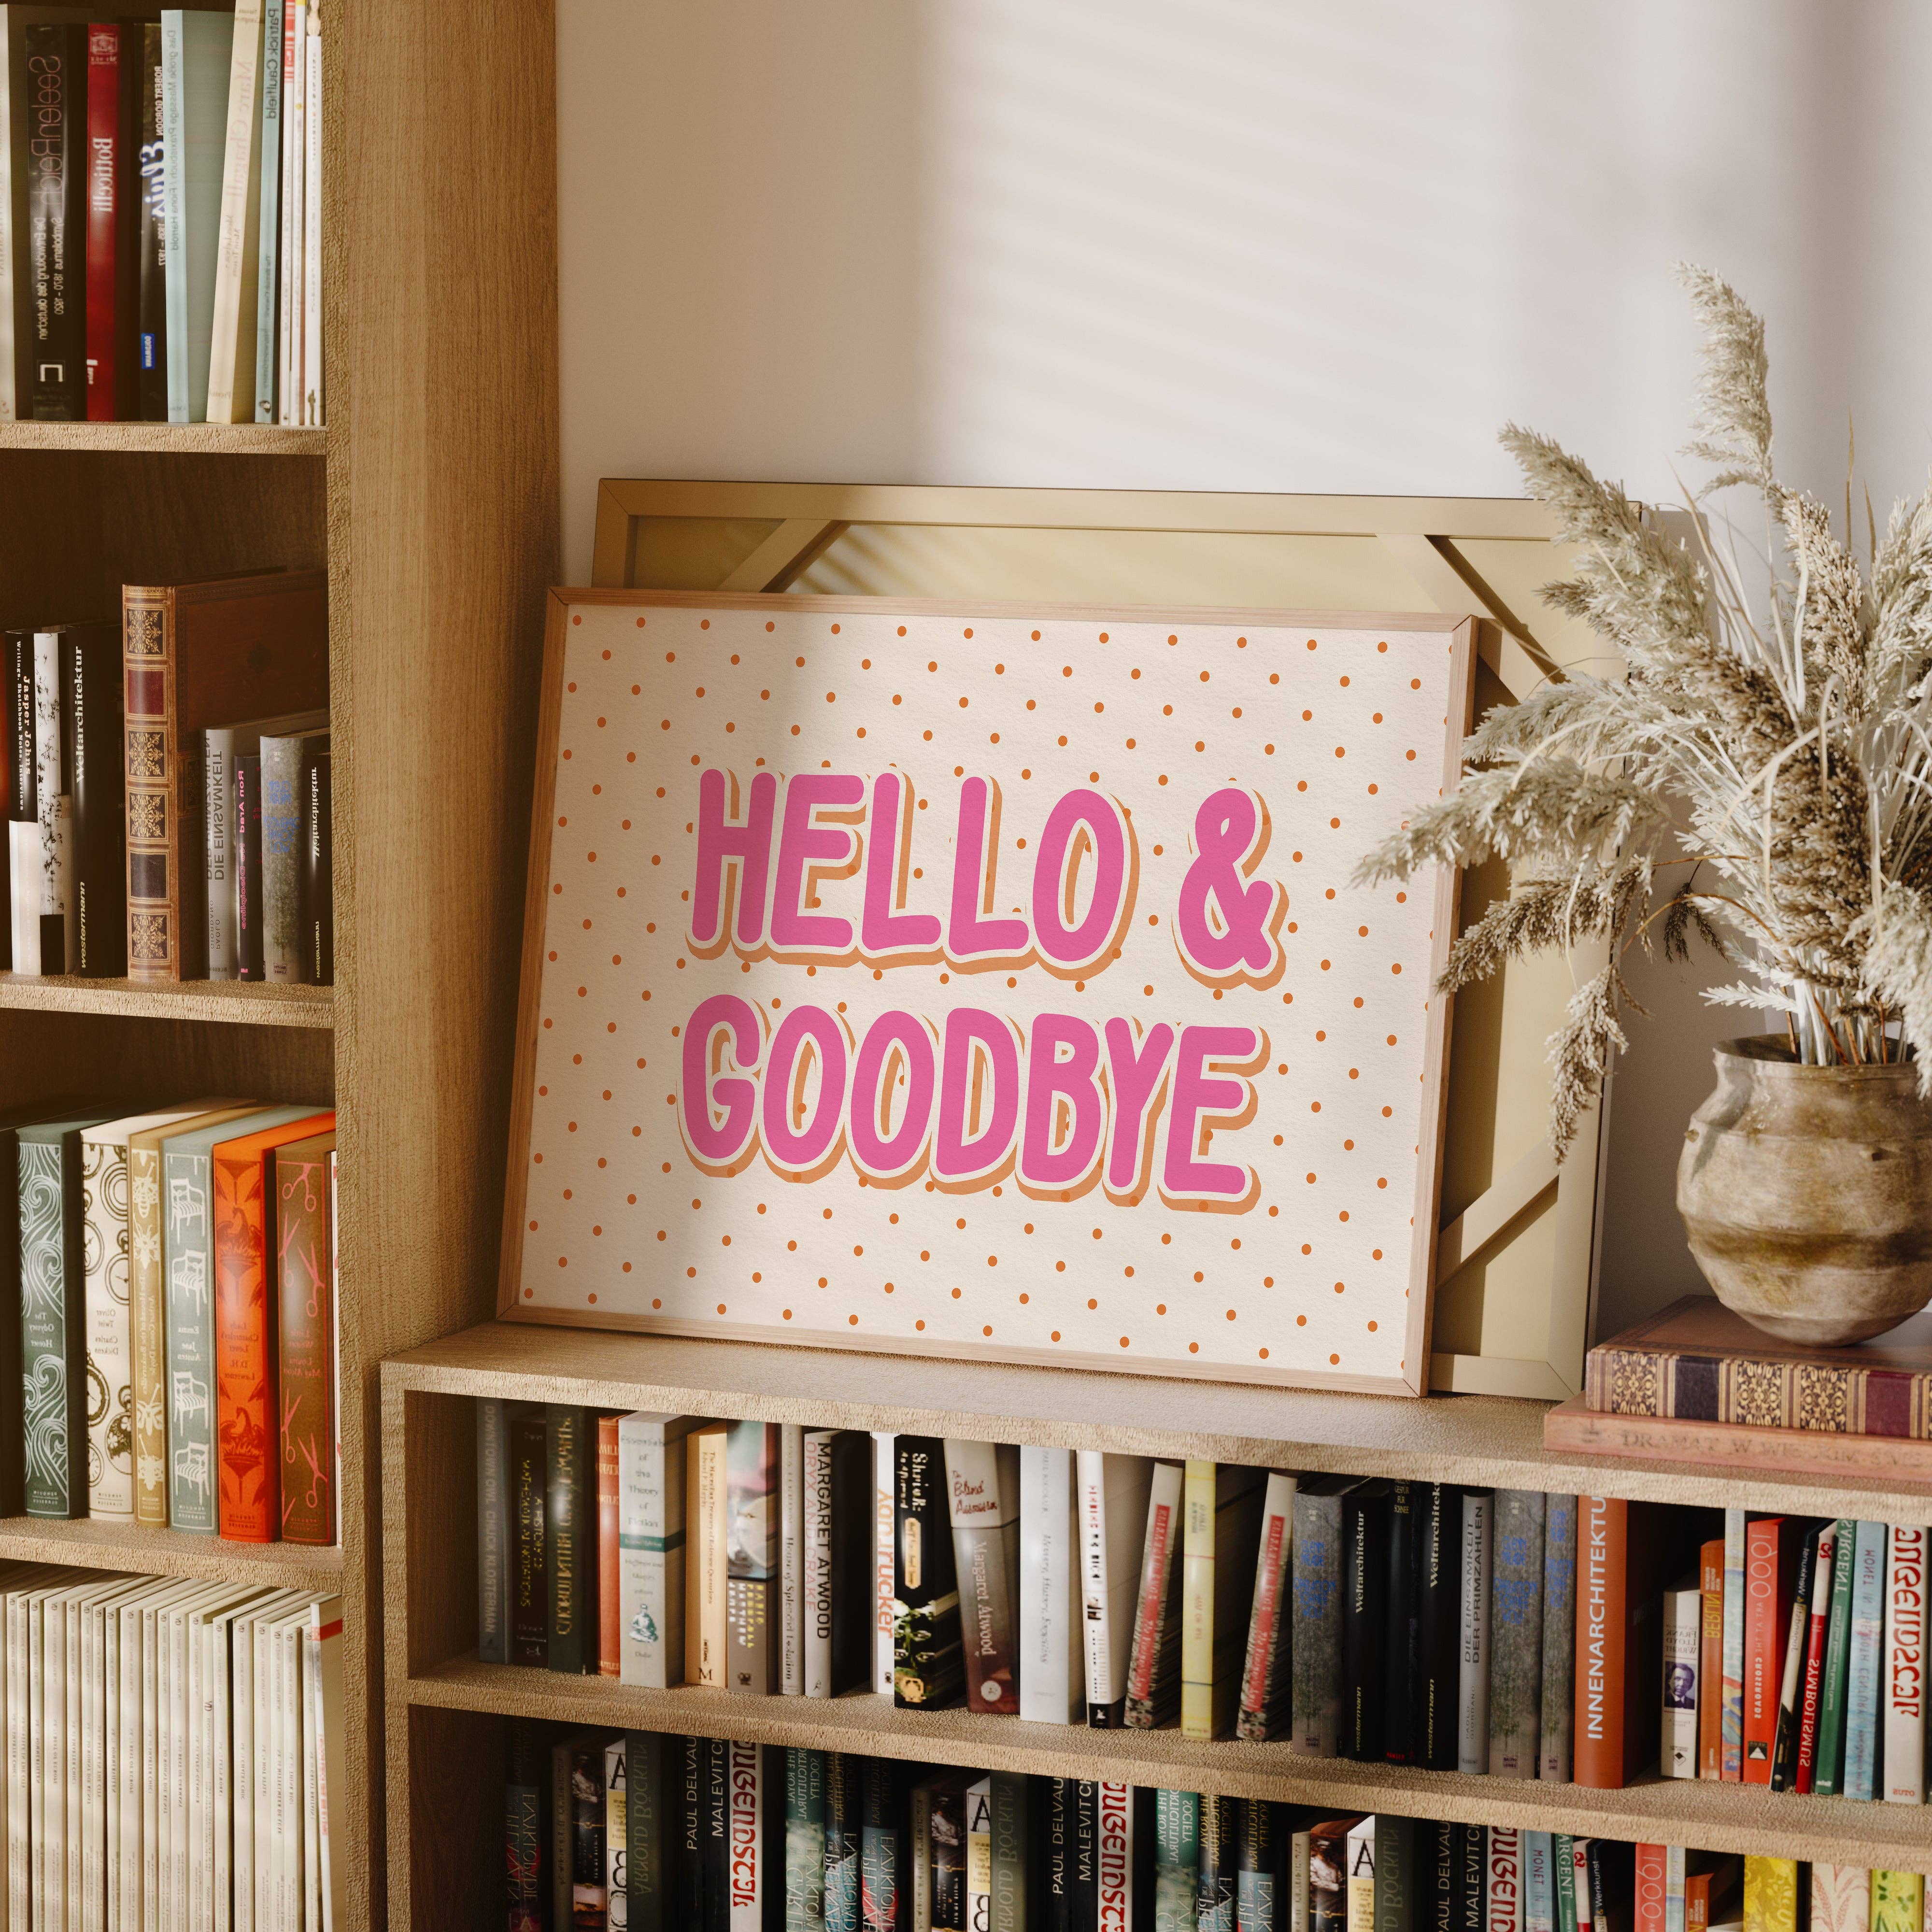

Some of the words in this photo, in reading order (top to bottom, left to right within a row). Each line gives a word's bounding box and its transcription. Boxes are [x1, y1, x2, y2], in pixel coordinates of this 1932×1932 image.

[74, 646, 85, 783] Weltarchitektur
[691, 769, 1135, 964] HELLO
[1177, 788, 1275, 973] &
[680, 994, 1261, 1196] GOODBYE
[485, 1406, 497, 1476] DOWNTOWN
[805, 1441, 817, 1492] ORYX
[485, 1479, 496, 1503] OWL
[629, 1484, 658, 1497] Theory
[817, 1442, 831, 1551] MARGARET
[954, 1480, 984, 1497] Blind
[956, 1499, 998, 1515] Assassin
[484, 1510, 497, 1552] CHUCK
[628, 1517, 658, 1528] Fiction
[805, 1499, 817, 1539] AND
[786, 1537, 794, 1571] House
[805, 1547, 817, 1612] CRAKE
[972, 1541, 990, 1601] Margaret
[1355, 1511, 1364, 1613] Weltarchitektur
[1464, 1520, 1474, 1629] EINSAMKEIT
[1473, 1506, 1483, 1621] PRIMZAHLEN
[484, 1555, 496, 1633] KLOSTERMAN
[738, 1583, 747, 1646] MATTHEW
[784, 1586, 795, 1632] Splendid
[817, 1557, 831, 1639] ATWOOD
[785, 1635, 794, 1680] Isolation
[978, 1605, 997, 1655] Atwood
[1426, 1678, 1435, 1760] westermann
[686, 1736, 697, 1802] DELVAU
[686, 1808, 697, 1850] PAUL
[1052, 1777, 1064, 1845] DELVAU
[1052, 1851, 1063, 1894] PAUL
[1438, 1821, 1450, 1890] DELVAU
[1533, 1849, 1544, 1885] MONET
[1592, 1861, 1602, 1907] Werkkunst
[1534, 1891, 1545, 1902] IN
[1636, 1855, 1663, 1919] 1900
